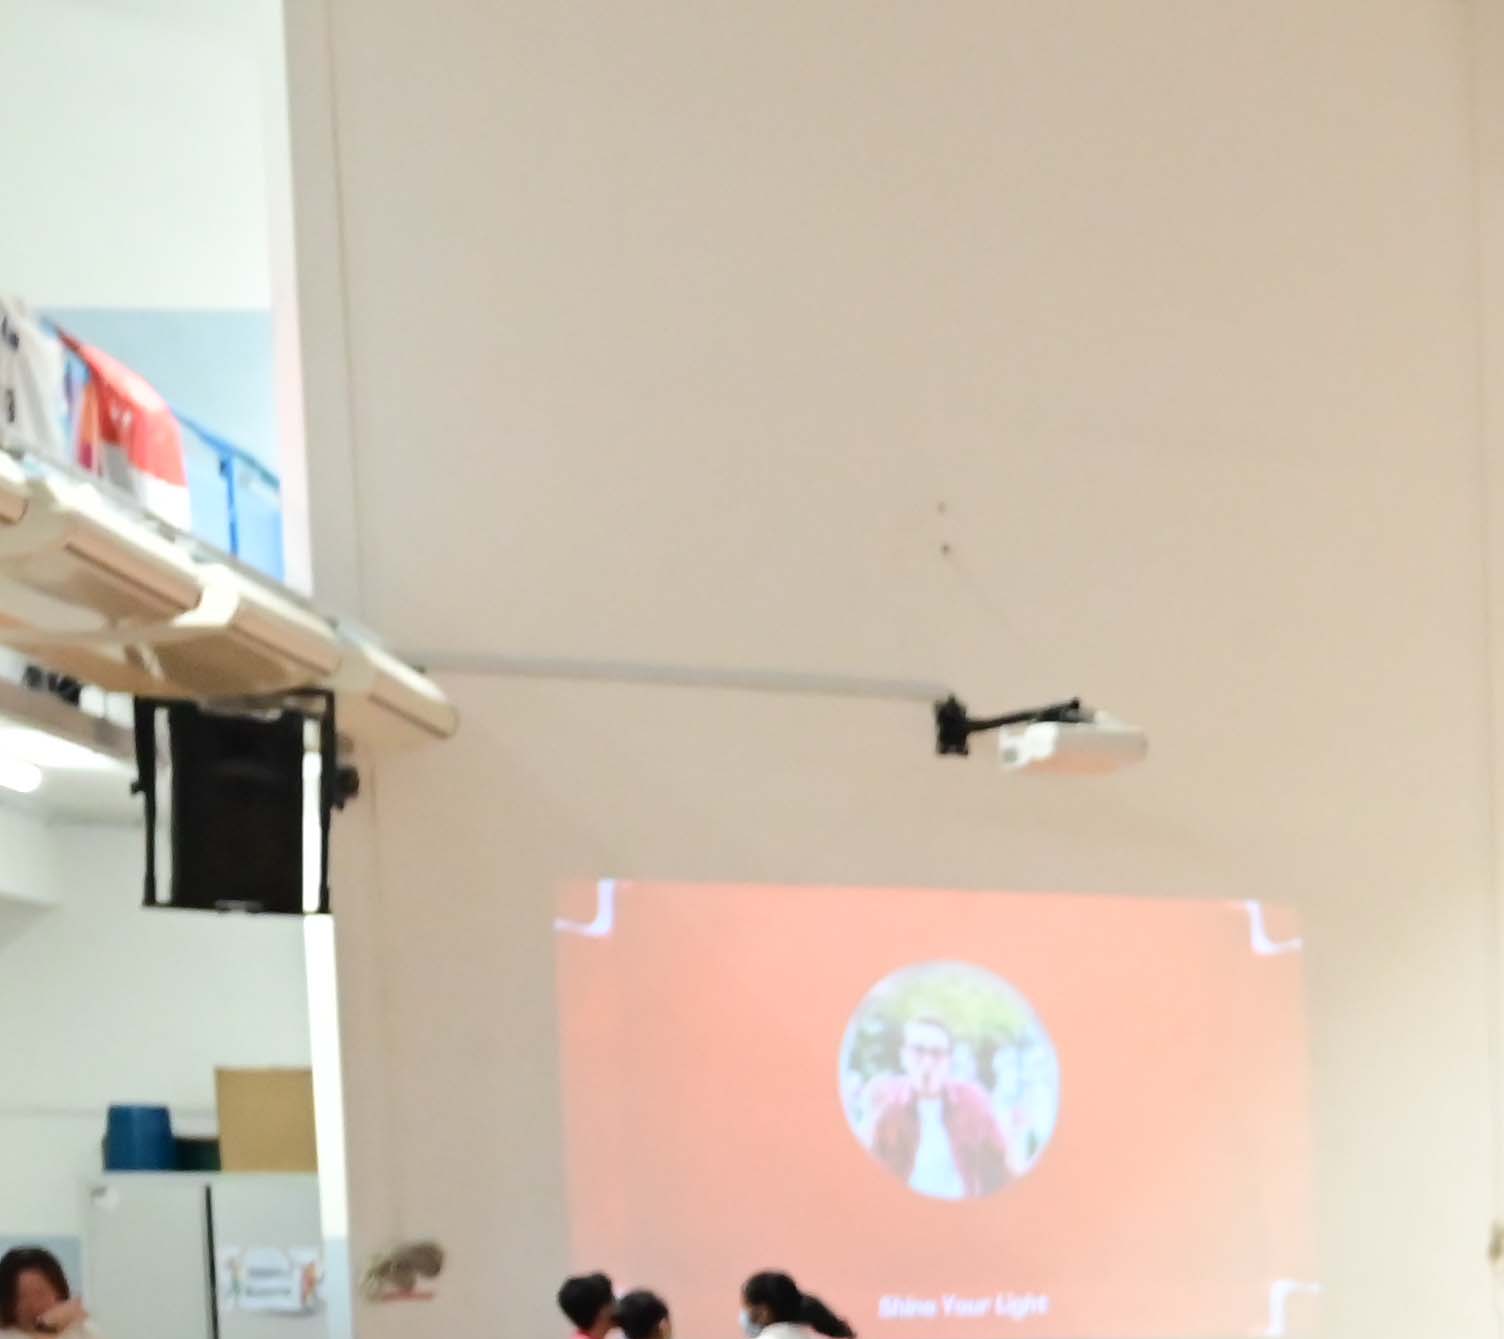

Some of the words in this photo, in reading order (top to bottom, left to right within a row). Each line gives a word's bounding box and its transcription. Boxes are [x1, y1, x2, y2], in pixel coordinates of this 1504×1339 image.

[878, 1294, 938, 1320] Shine
[941, 1294, 991, 1318] Your
[993, 1291, 1050, 1322] Light
